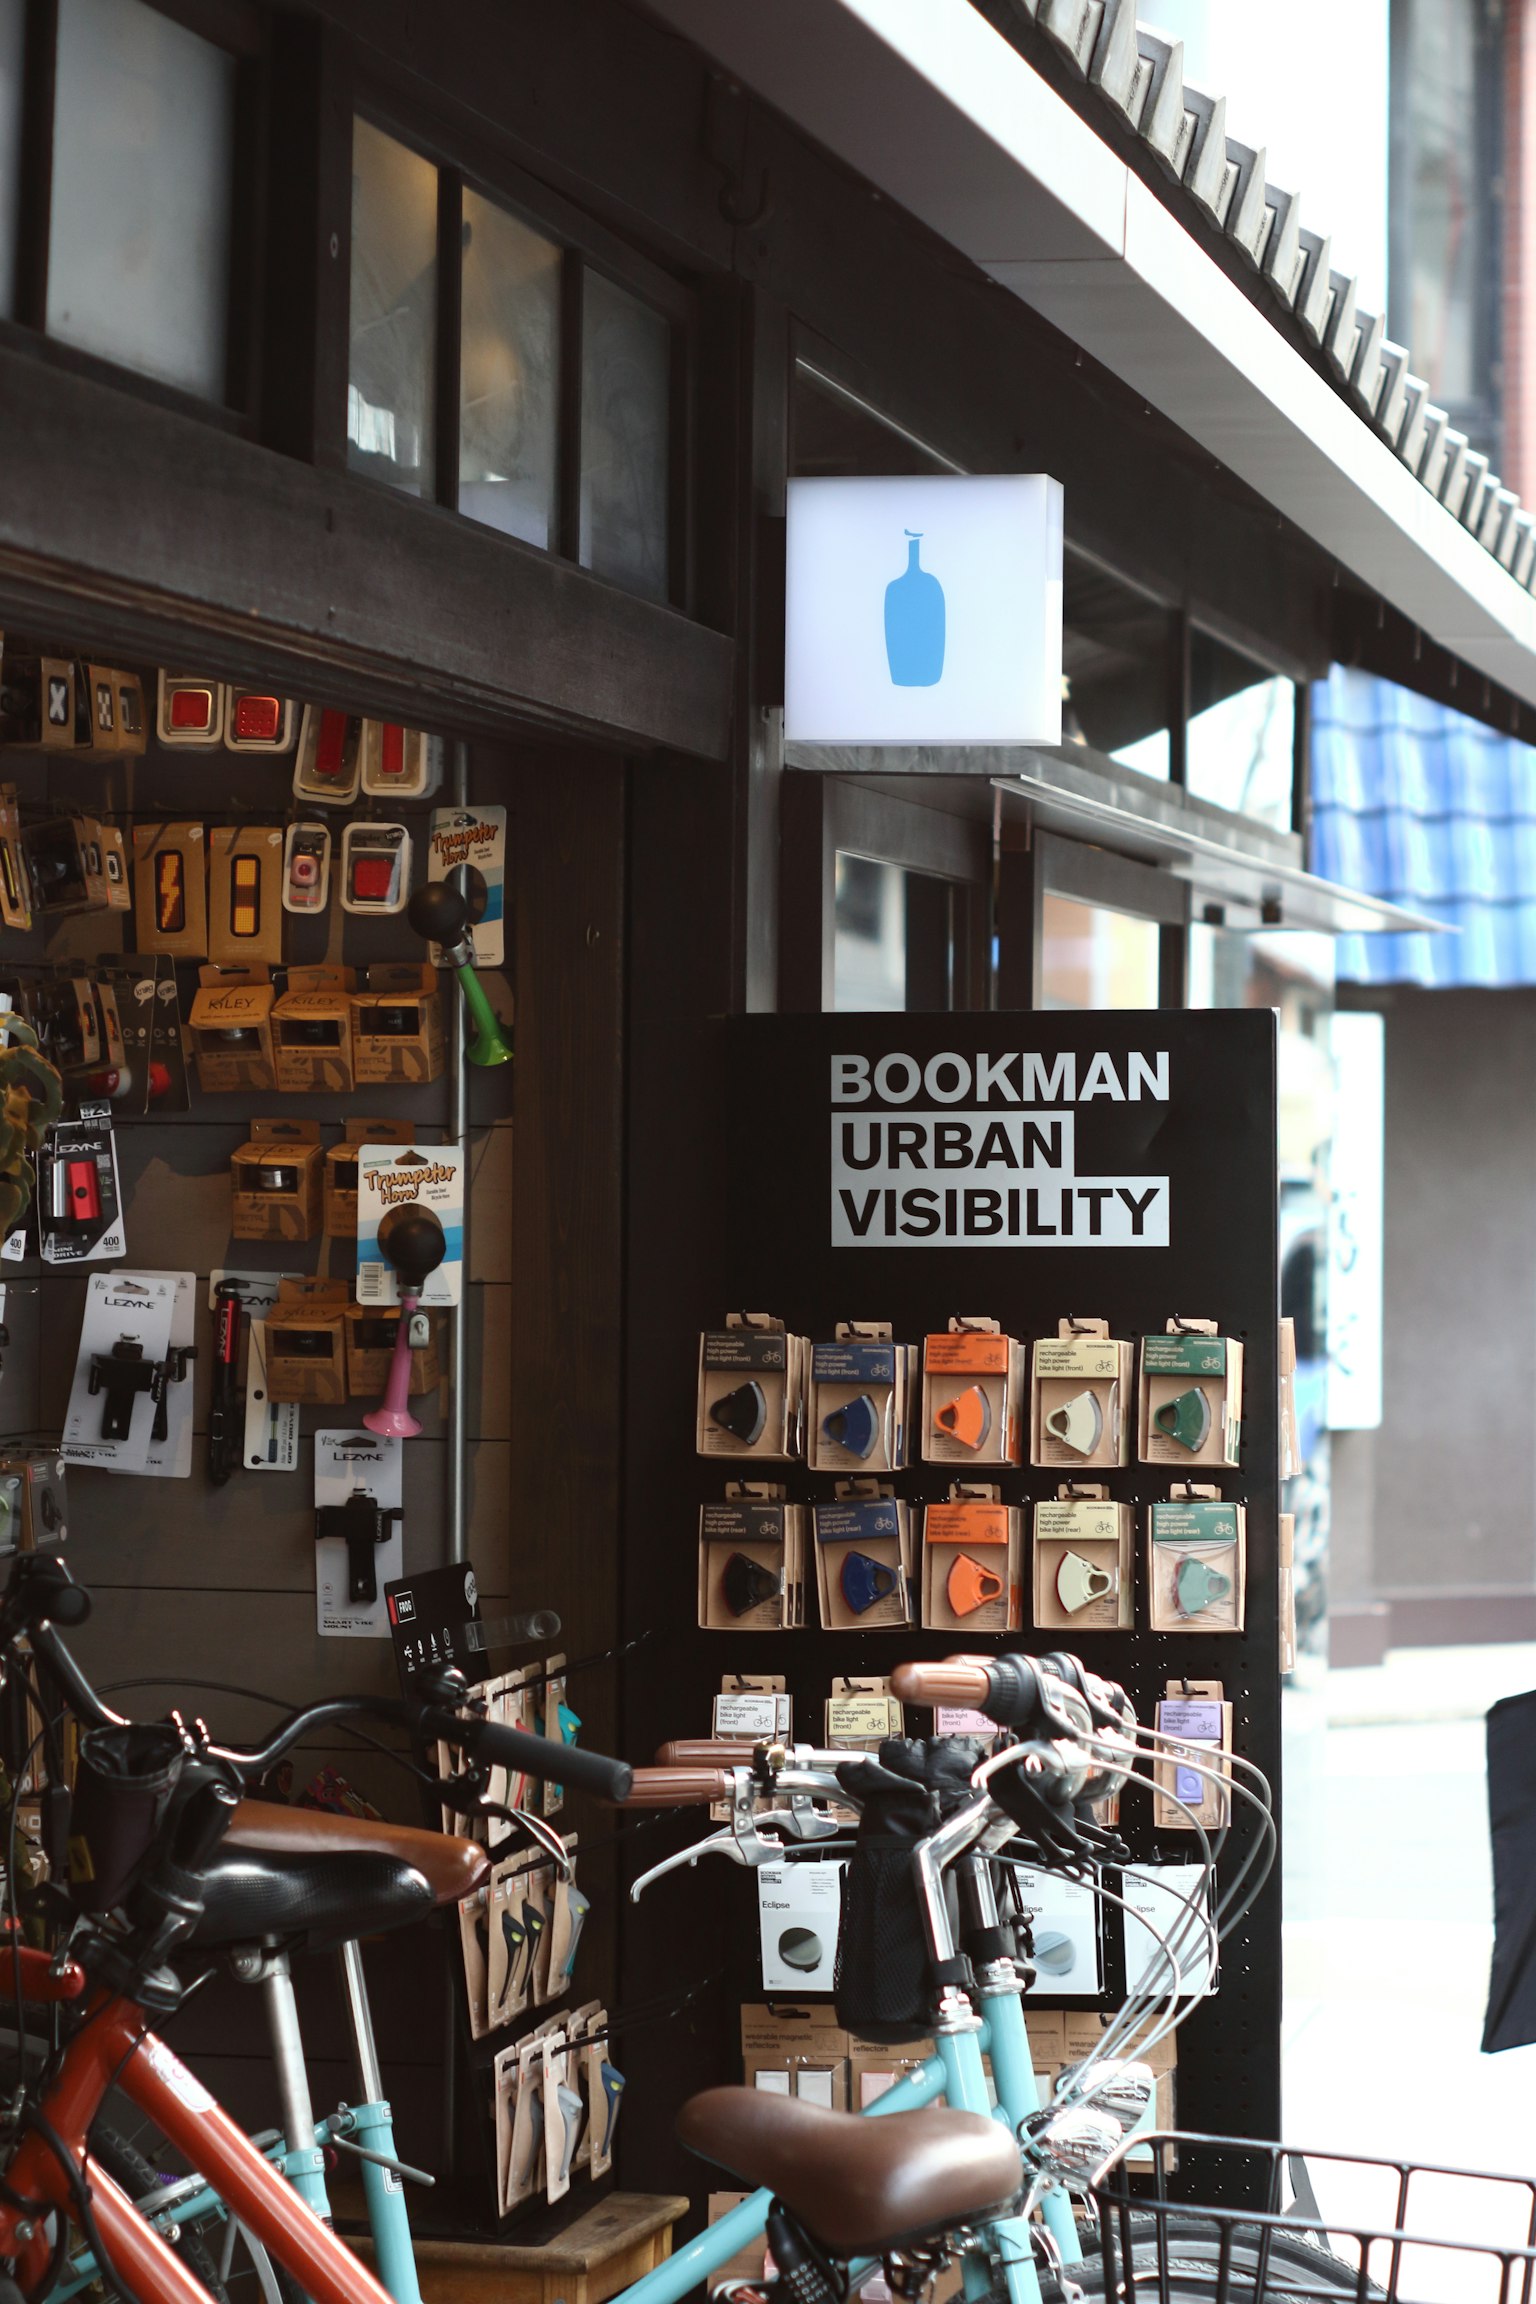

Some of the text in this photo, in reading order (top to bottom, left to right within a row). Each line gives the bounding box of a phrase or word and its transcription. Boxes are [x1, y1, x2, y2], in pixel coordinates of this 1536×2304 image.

[431, 821, 499, 853] Trumpeter
[441, 849, 469, 867] Horn
[831, 1052, 1169, 1103] BOOKMAN
[842, 1121, 1062, 1170] URBAN
[363, 1162, 457, 1190] Trumpeter
[381, 1187, 419, 1205] Horn
[839, 1188, 1160, 1236] VISIBILITY
[10, 1238, 22, 1249] 400
[103, 1236, 119, 1246] 400
[104, 1296, 155, 1310] LEZYNE
[333, 1452, 384, 1461] LEZYNE
[1052, 1526, 1065, 1534] light
[1065, 1526, 1081, 1534] (rear)
[398, 1600, 412, 1614] FROG
[846, 1716, 859, 1724] light
[762, 1901, 791, 1910] Eclipse
[1024, 1905, 1043, 1913] lipse
[779, 2034, 813, 2042] magnetic
